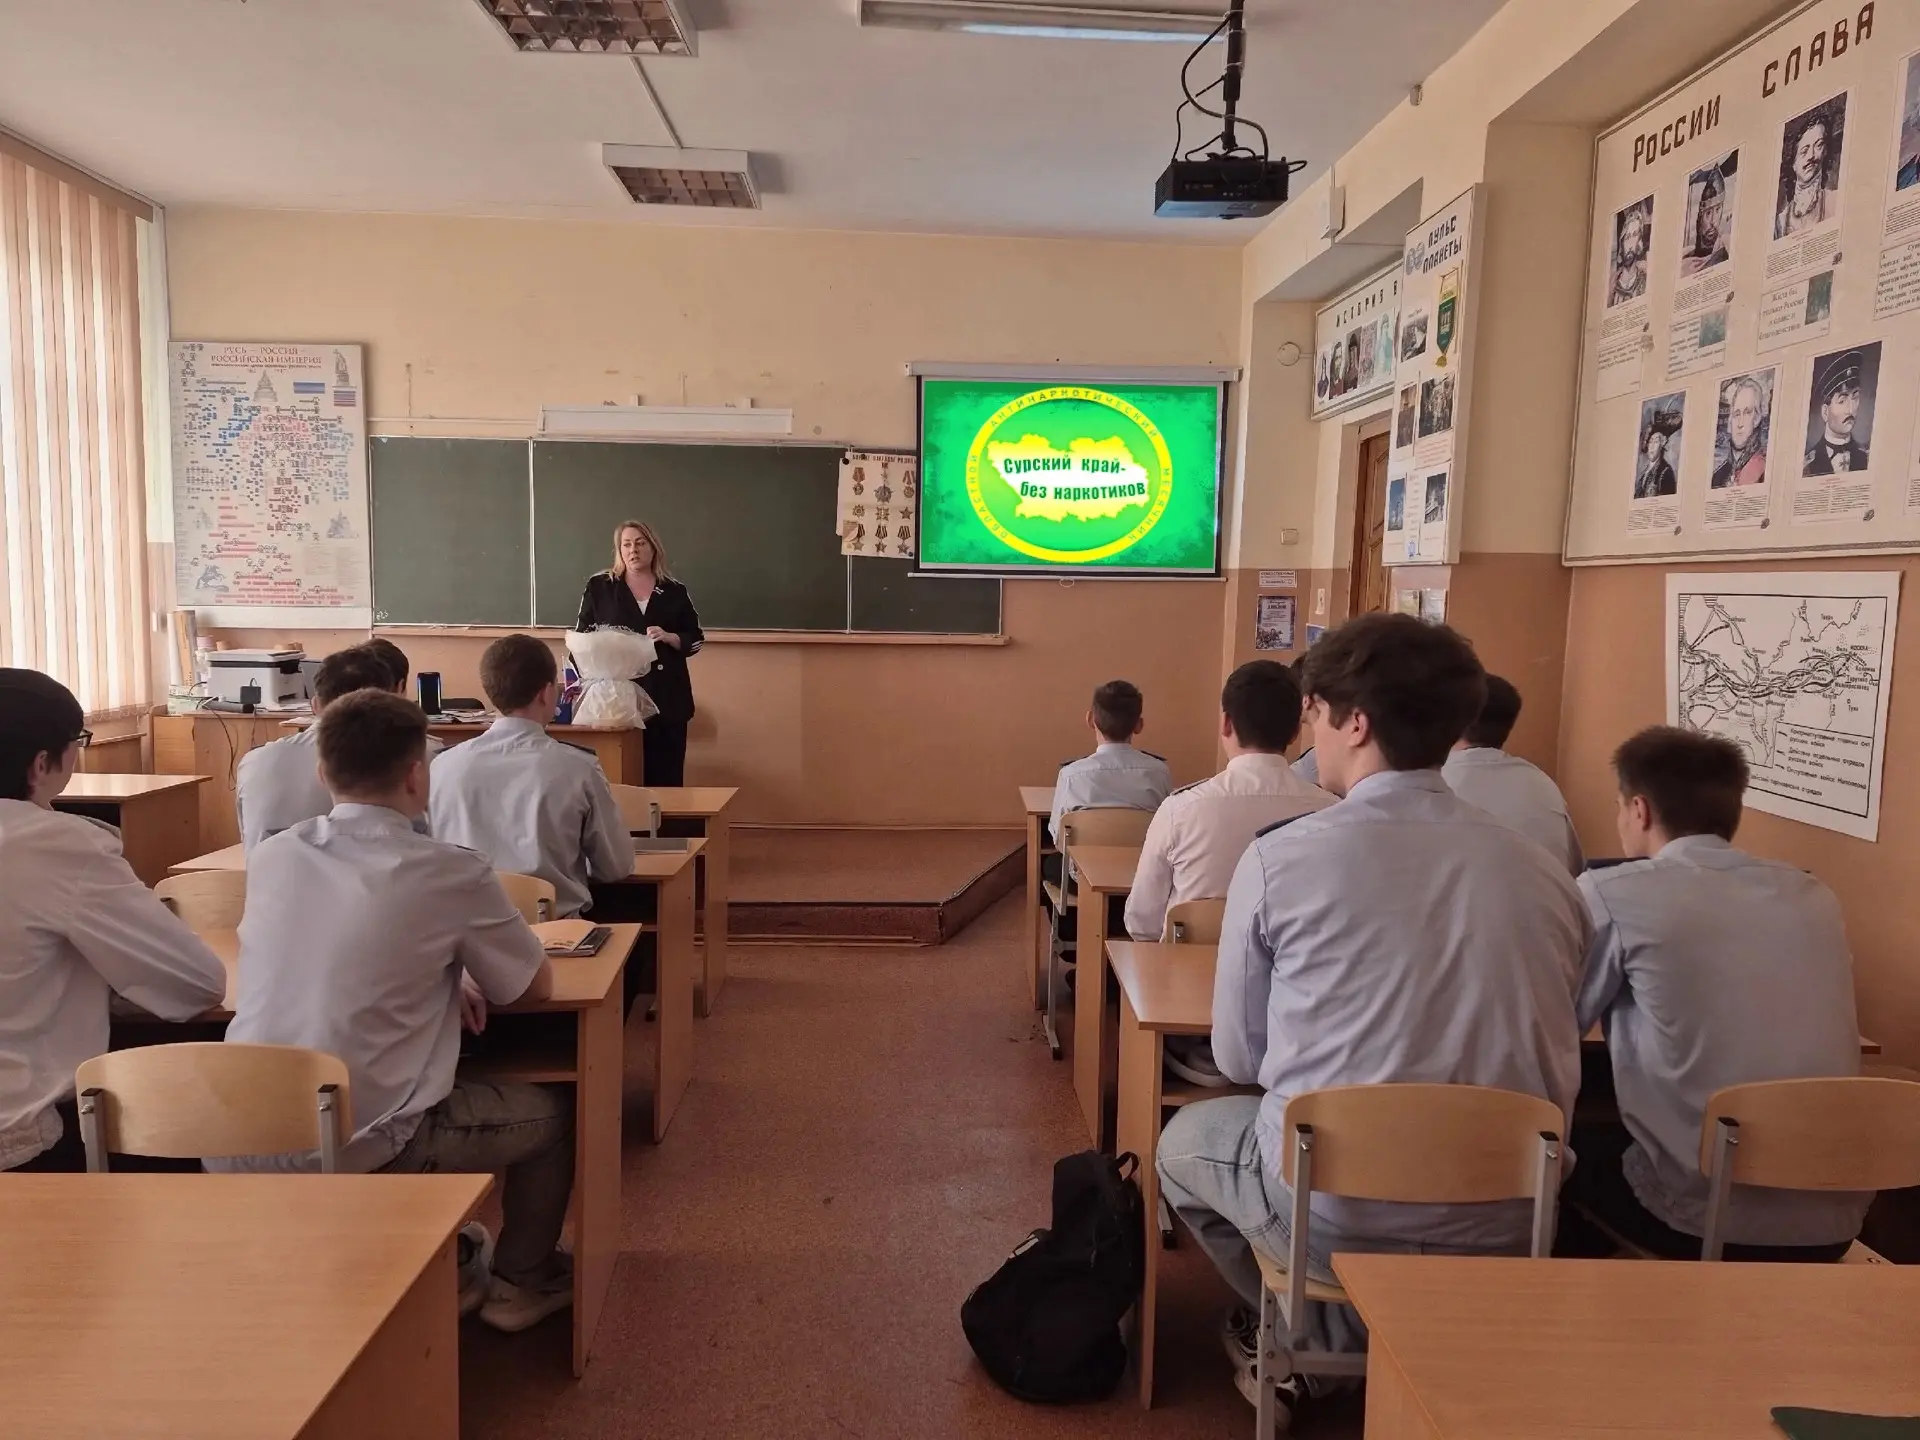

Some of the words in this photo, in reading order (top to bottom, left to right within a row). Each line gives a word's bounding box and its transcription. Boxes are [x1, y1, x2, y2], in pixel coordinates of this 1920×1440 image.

[1632, 94, 1721, 173] РОССИИ
[1762, 1, 1875, 99] СЛАВА
[1428, 215, 1457, 246] ПУЛЬС
[1422, 236, 1462, 274] ПЛАНЕТЫ
[1336, 288, 1384, 328] ИСТОРИЯ
[211, 355, 274, 364] РОССИЙСКАЯ
[276, 356, 322, 364] ИМПЕРИЯ
[224, 346, 247, 354] РУСЬ
[260, 347, 298, 355] РОССИЯ
[990, 389, 1159, 439] АНТИНАРКОТИЧЕСКИЙ
[1004, 455, 1071, 474] Сурский
[1082, 457, 1126, 474] край-
[970, 454, 1008, 539] ОБЛАСТНОЙ
[1020, 482, 1047, 499] без
[1054, 482, 1145, 501] наркотиков
[1128, 467, 1170, 543] МЕСЯЧНИК
